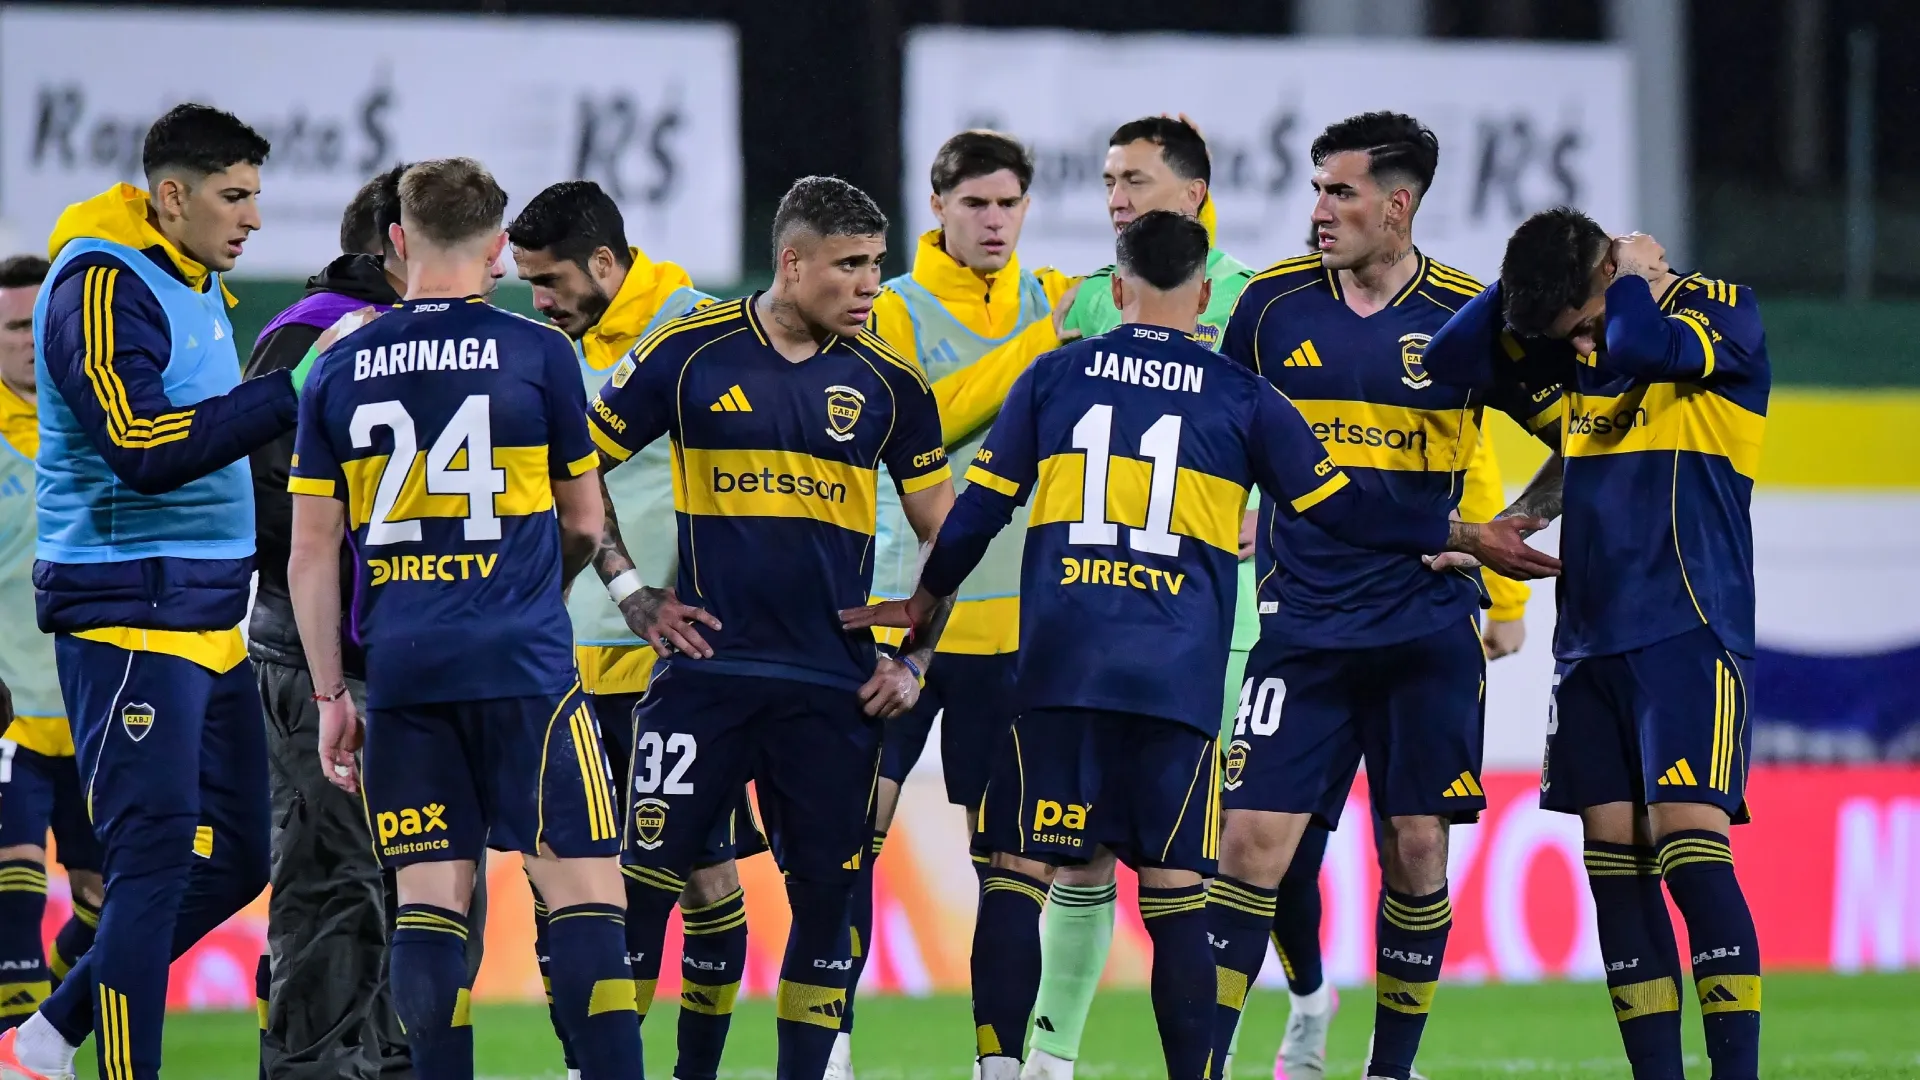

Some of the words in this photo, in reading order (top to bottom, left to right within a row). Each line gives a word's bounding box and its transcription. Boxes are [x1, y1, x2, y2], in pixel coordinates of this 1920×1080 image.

[1132, 328, 1170, 342] 1905
[354, 337, 499, 381] BARINAGA
[1084, 351, 1204, 393] JANSON
[832, 406, 855, 417] CABJ
[349, 394, 505, 545] 24
[913, 447, 946, 468] CETR
[976, 448, 993, 464] AR
[713, 466, 847, 503] betsson
[1068, 403, 1182, 557] 11
[367, 553, 499, 586] DIRECTV
[1060, 557, 1185, 596] DIRECTV
[127, 715, 149, 724] CABJ
[1234, 676, 1287, 736] 40
[635, 731, 697, 795] 32
[377, 803, 448, 846] pax
[1034, 799, 1092, 831] pa
[384, 839, 449, 856] assistance
[1032, 833, 1084, 847] assista
[0, 959, 40, 970] ABJ
[1383, 947, 1433, 966] CABJ
[1693, 946, 1741, 965] CABJ
